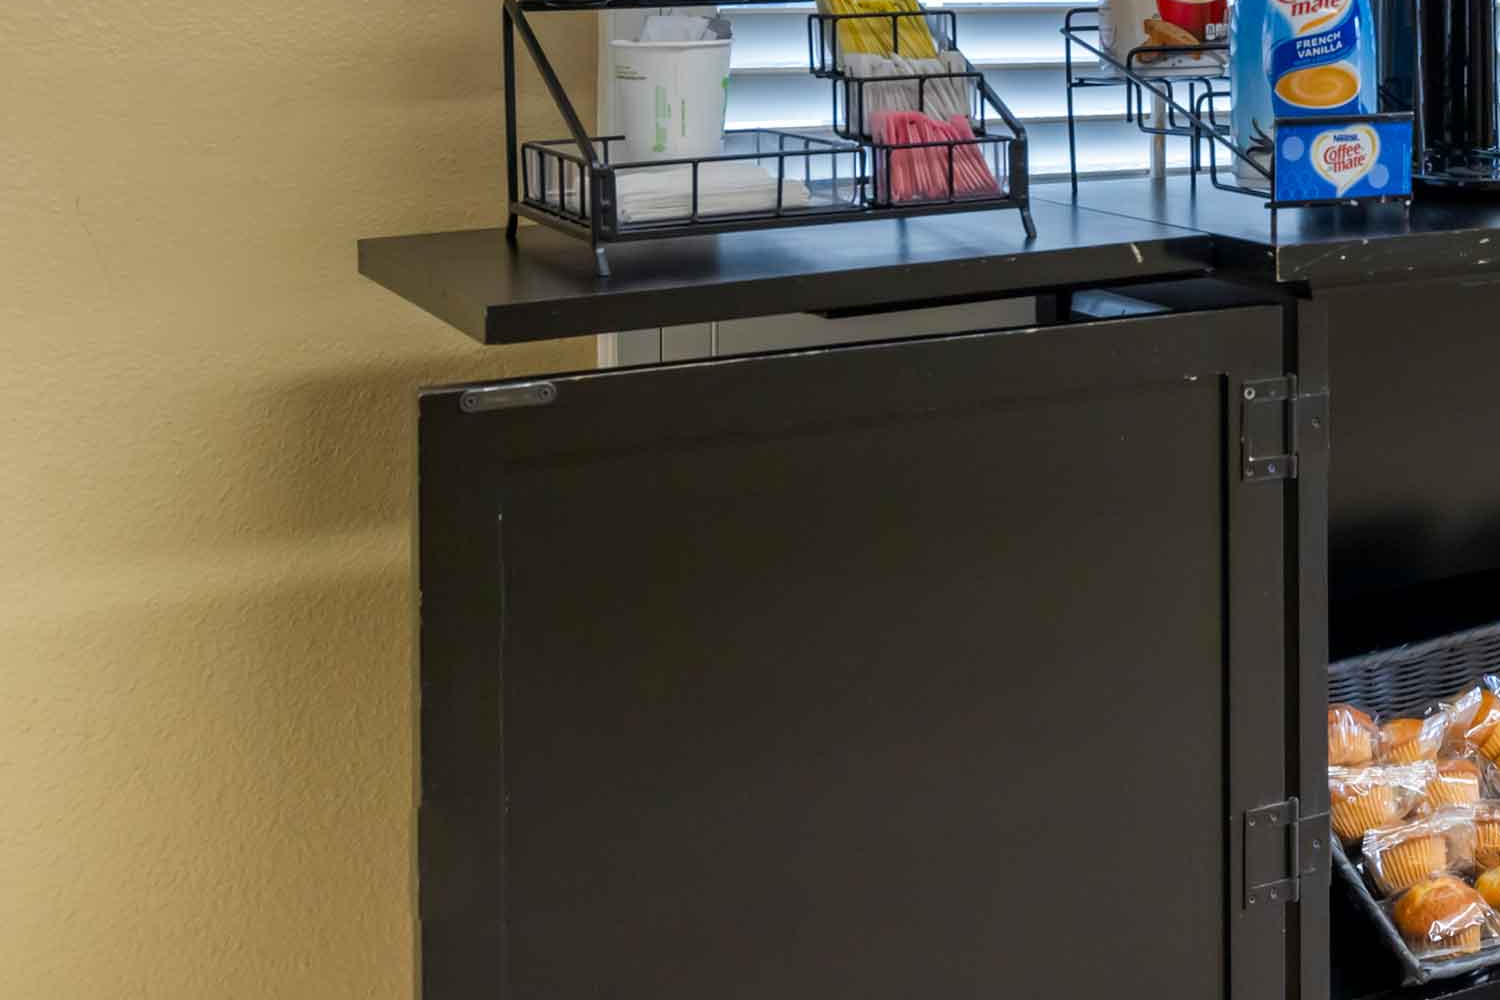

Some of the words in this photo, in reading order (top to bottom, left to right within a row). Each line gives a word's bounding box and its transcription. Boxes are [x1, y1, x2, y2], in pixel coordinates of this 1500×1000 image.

[1296, 31, 1342, 50] FRENCH
[1296, 41, 1343, 59] VANILLA
[1324, 143, 1361, 165] Coffee
[1333, 155, 1366, 173] mate
